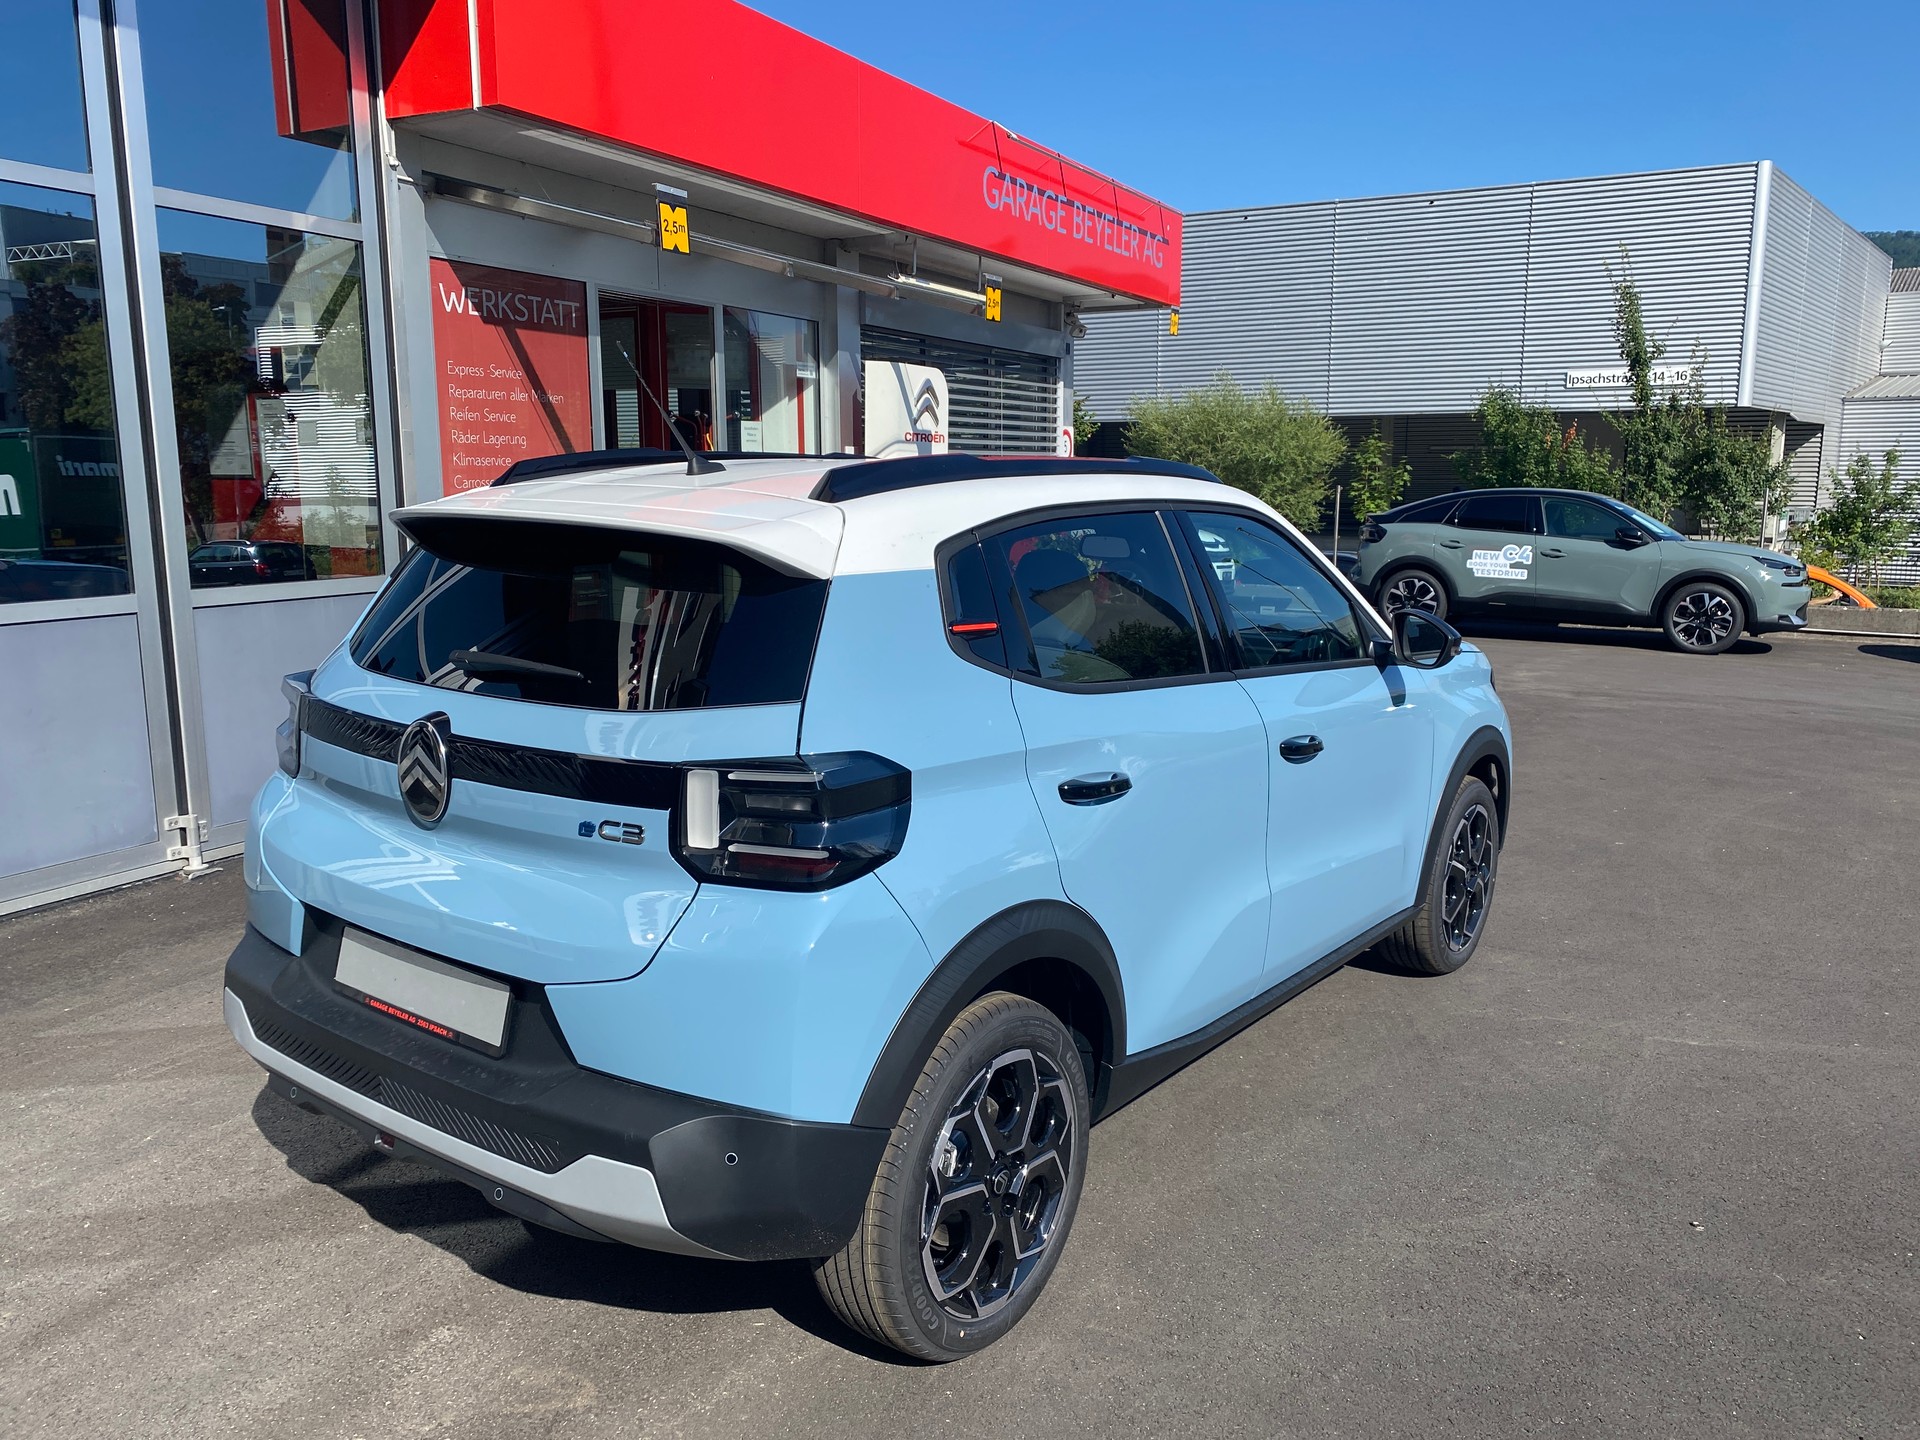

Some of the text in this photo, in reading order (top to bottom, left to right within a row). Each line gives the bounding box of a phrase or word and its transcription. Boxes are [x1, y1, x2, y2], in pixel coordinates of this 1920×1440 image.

[982, 165, 1163, 269] GARAGE BEYELER AG
[663, 218, 686, 236] 2,5m
[438, 282, 580, 329] WERKSTATT
[447, 360, 485, 379] Express
[448, 383, 565, 404] Reparaturen aller Marken
[449, 406, 517, 423] Reifen Service
[451, 429, 527, 449] Räder Lagerung
[452, 452, 512, 467] Klimaservice
[1474, 546, 1531, 563] NEW C4
[1475, 568, 1526, 578] TESTDRIVE
[370, 999, 389, 1012] GARAGE
[387, 1006, 409, 1021] BEYELER
